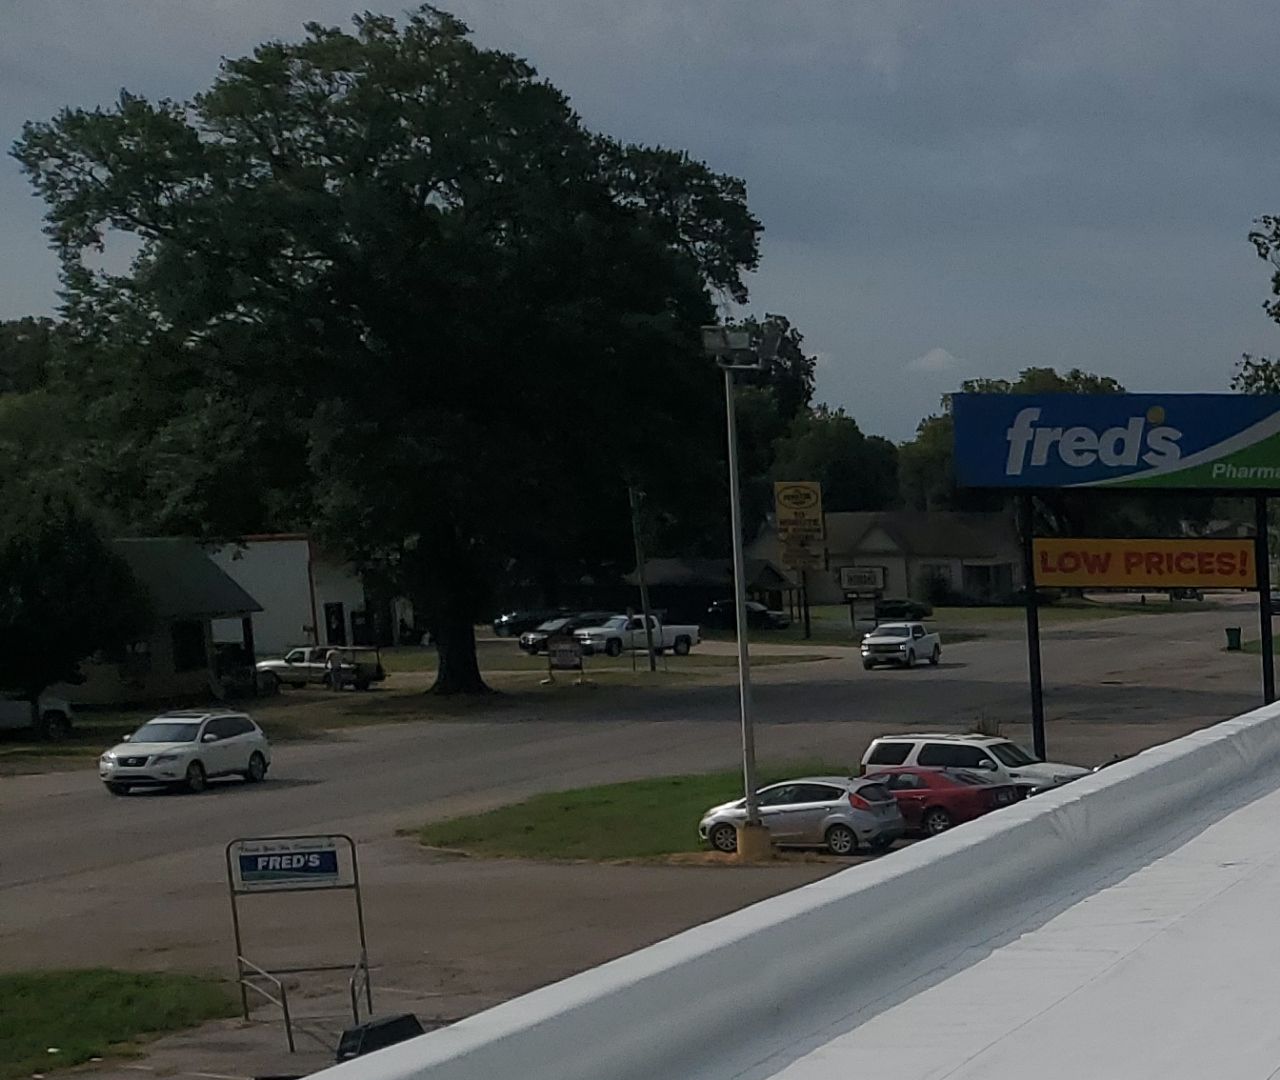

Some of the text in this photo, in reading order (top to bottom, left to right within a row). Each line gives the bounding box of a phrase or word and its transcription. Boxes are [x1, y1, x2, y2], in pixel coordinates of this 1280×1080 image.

[1005, 405, 1183, 476] fred's
[1039, 549, 1248, 577] LOW PRICES!
[256, 853, 321, 871] FRED'S
